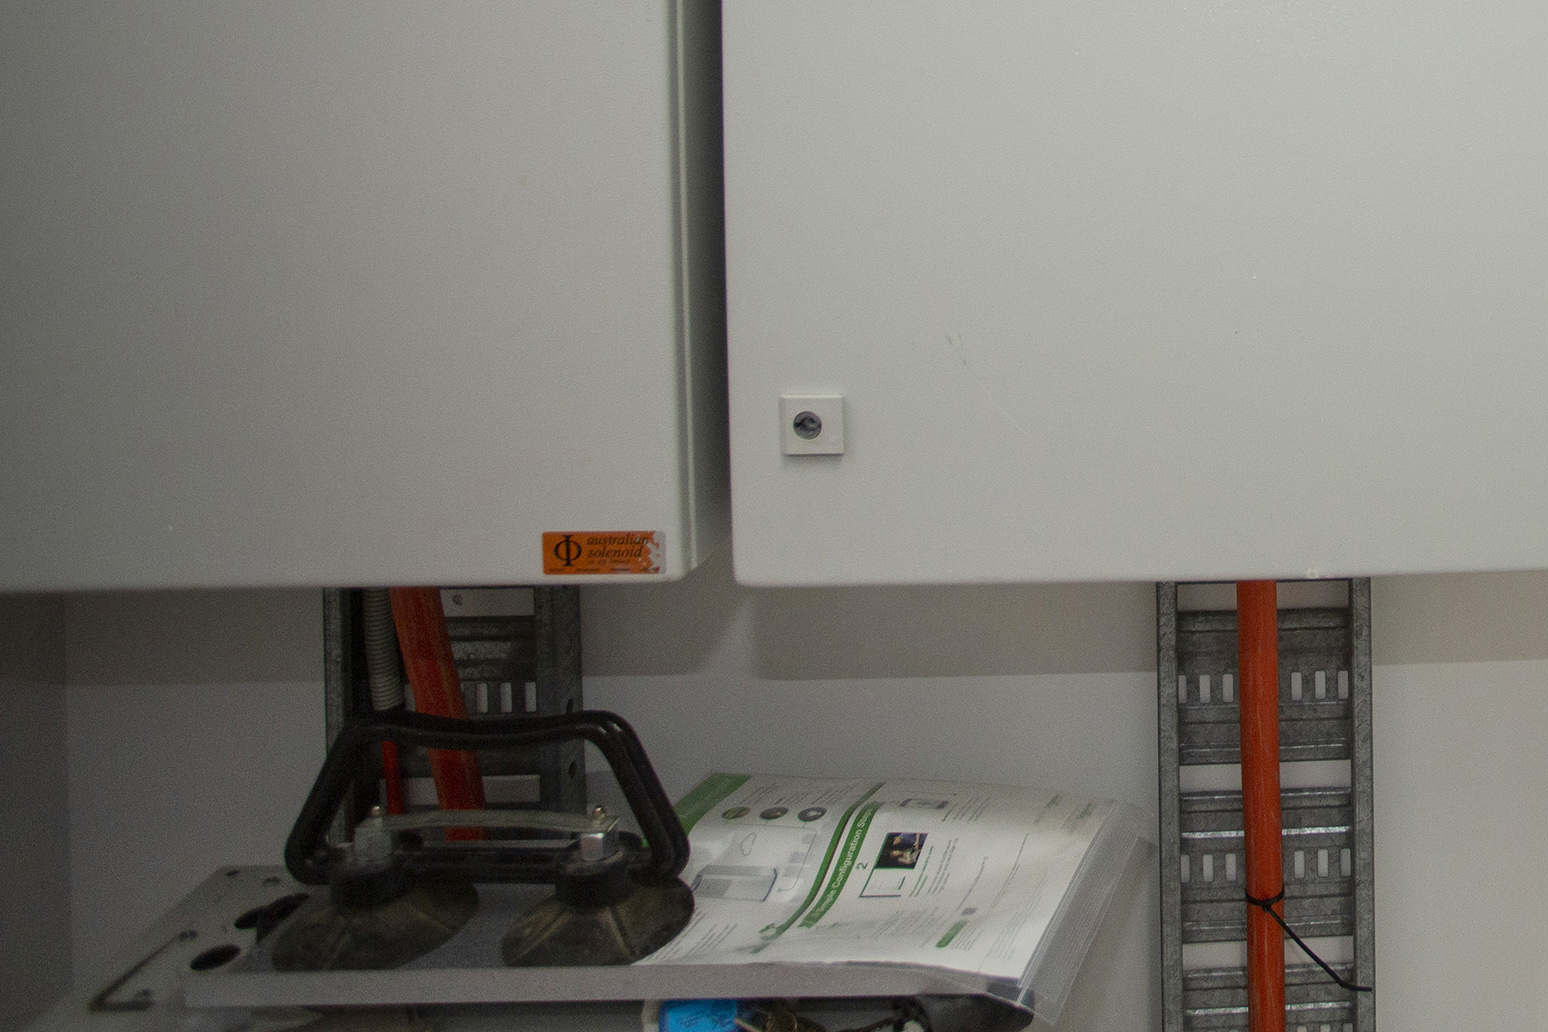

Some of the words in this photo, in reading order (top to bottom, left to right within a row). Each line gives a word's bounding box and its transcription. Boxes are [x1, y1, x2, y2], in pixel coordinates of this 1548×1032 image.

[587, 533, 649, 545] australian
[588, 546, 643, 558] solenoid
[832, 829, 862, 888] Configuration
